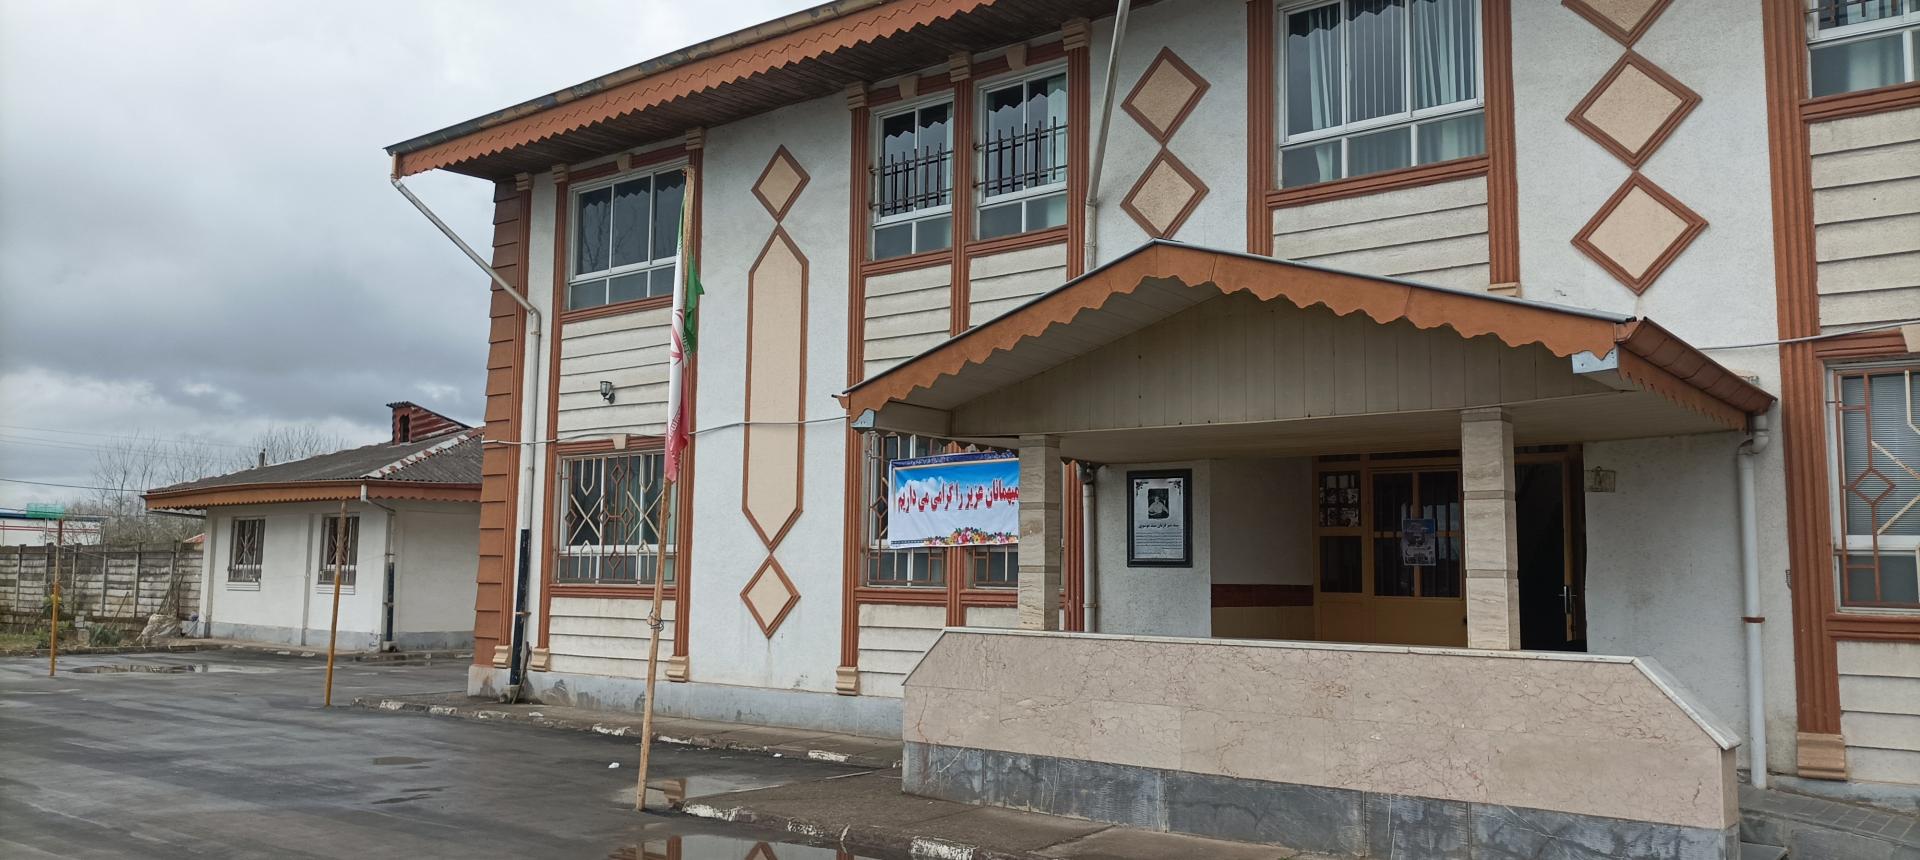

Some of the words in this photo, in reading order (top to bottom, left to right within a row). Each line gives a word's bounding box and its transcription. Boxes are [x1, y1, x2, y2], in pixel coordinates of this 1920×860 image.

[898, 486, 916, 513] داریم
[918, 492, 929, 512] می
[931, 483, 954, 512] گرامی
[955, 482, 963, 510] را
[965, 485, 984, 510] عزیز
